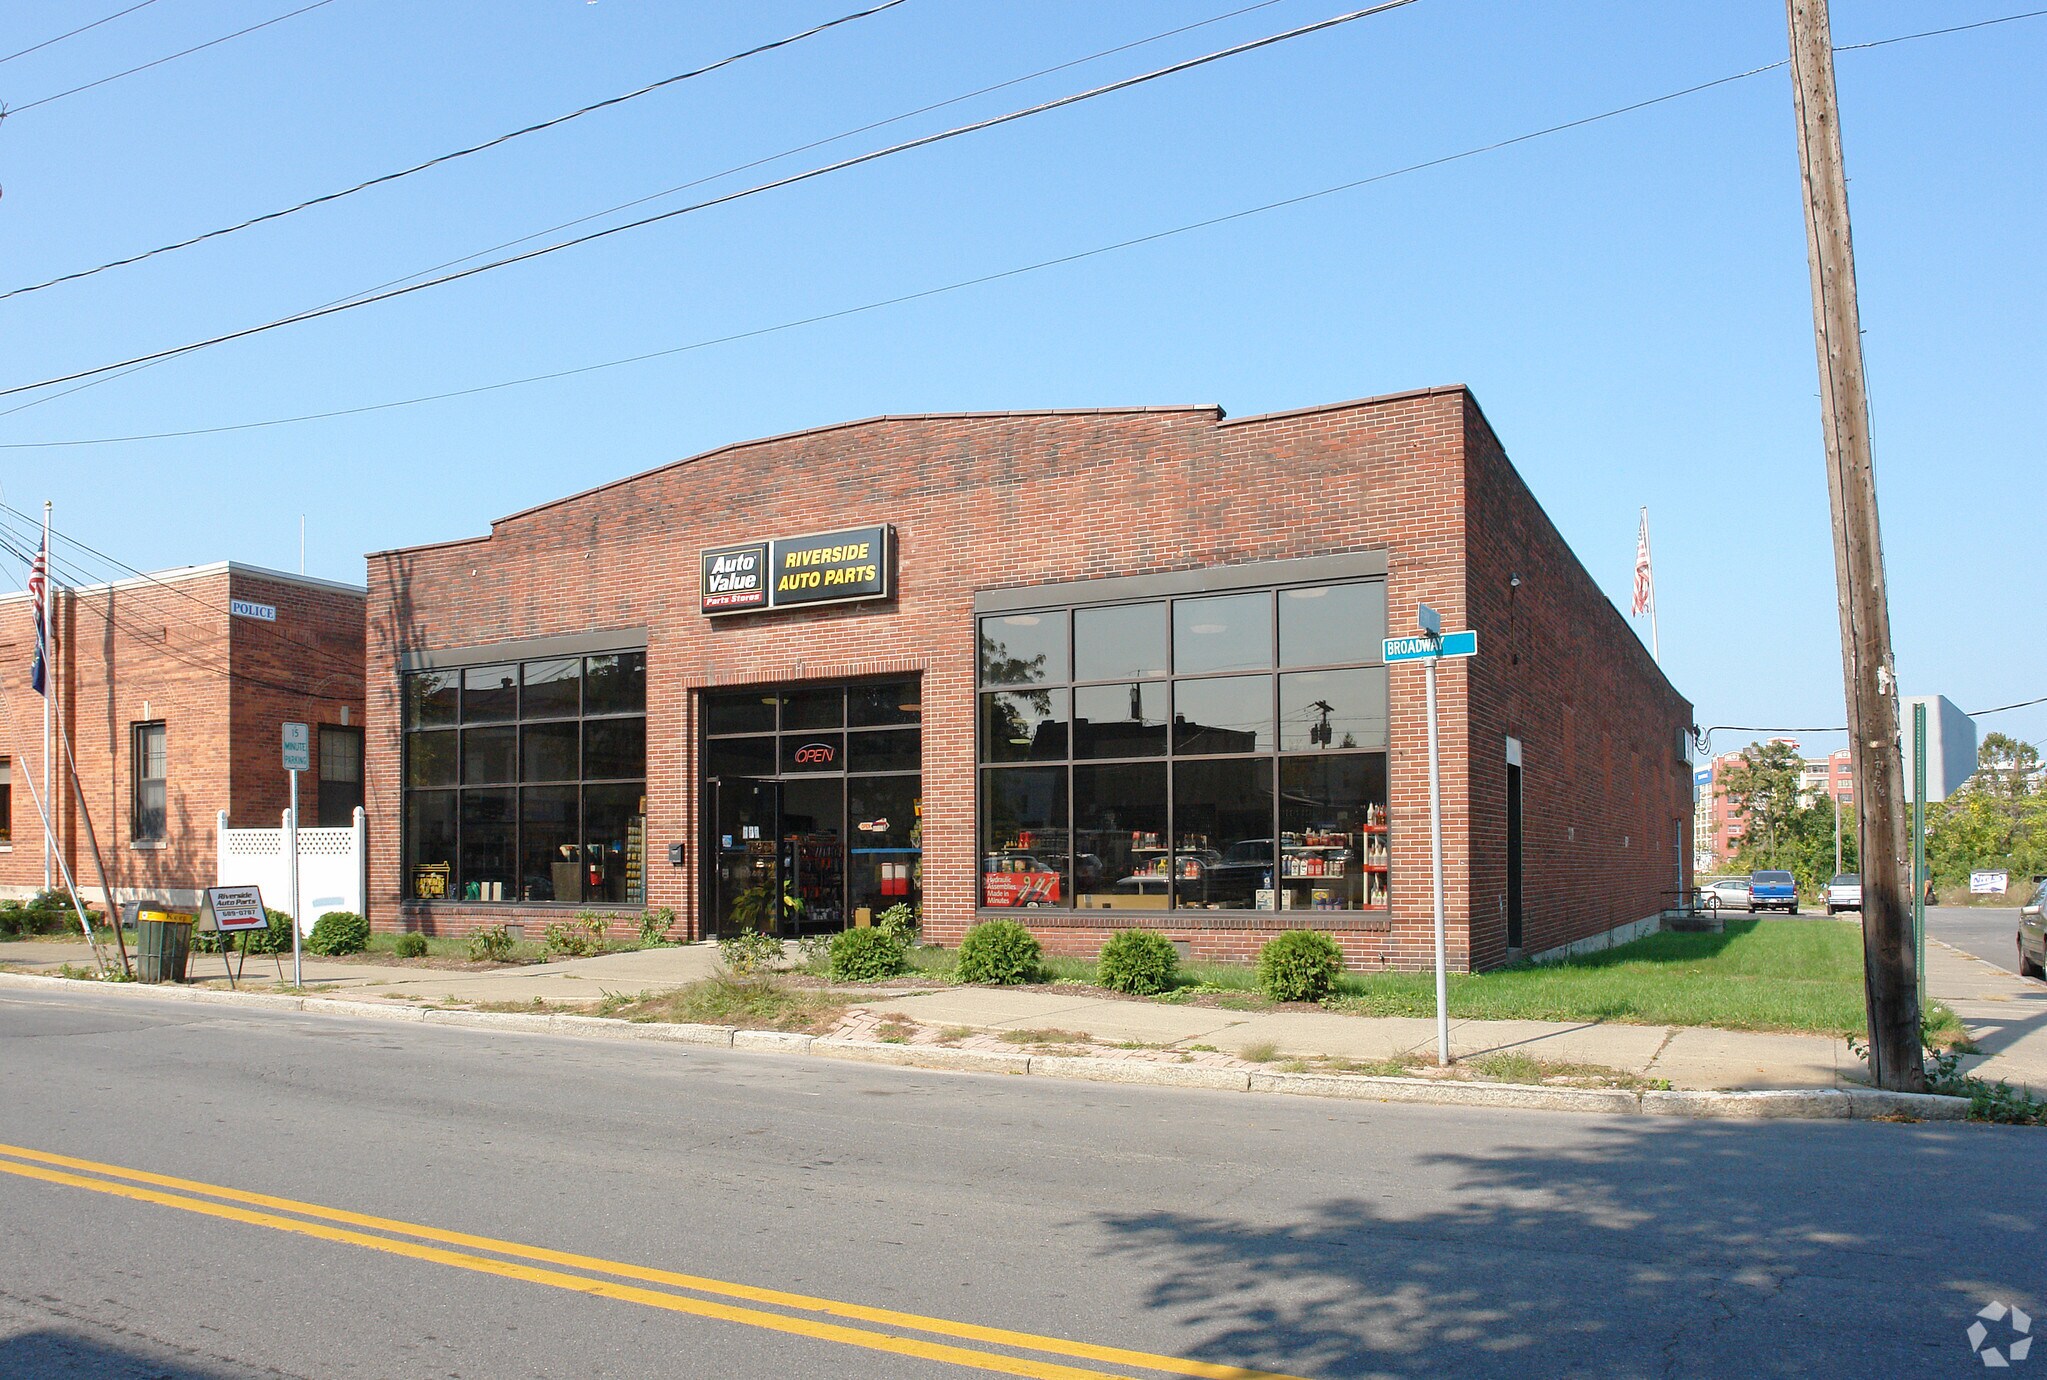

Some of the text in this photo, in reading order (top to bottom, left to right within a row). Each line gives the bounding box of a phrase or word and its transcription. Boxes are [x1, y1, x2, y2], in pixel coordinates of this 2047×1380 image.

[785, 542, 870, 568] RIVERSIDE
[711, 553, 755, 574] Auto
[709, 572, 757, 593] Value
[777, 564, 876, 592] AUTO PARTS
[706, 593, 760, 606] Parts Stores
[233, 602, 274, 619] POLICE
[1387, 636, 1445, 656] BROADWAY
[292, 729, 299, 737] 15
[284, 742, 306, 751] MINUTE
[285, 755, 307, 765] PARKING
[796, 747, 835, 763] OPEN
[987, 876, 1012, 884] Hydraulic
[217, 892, 253, 900] Riverside
